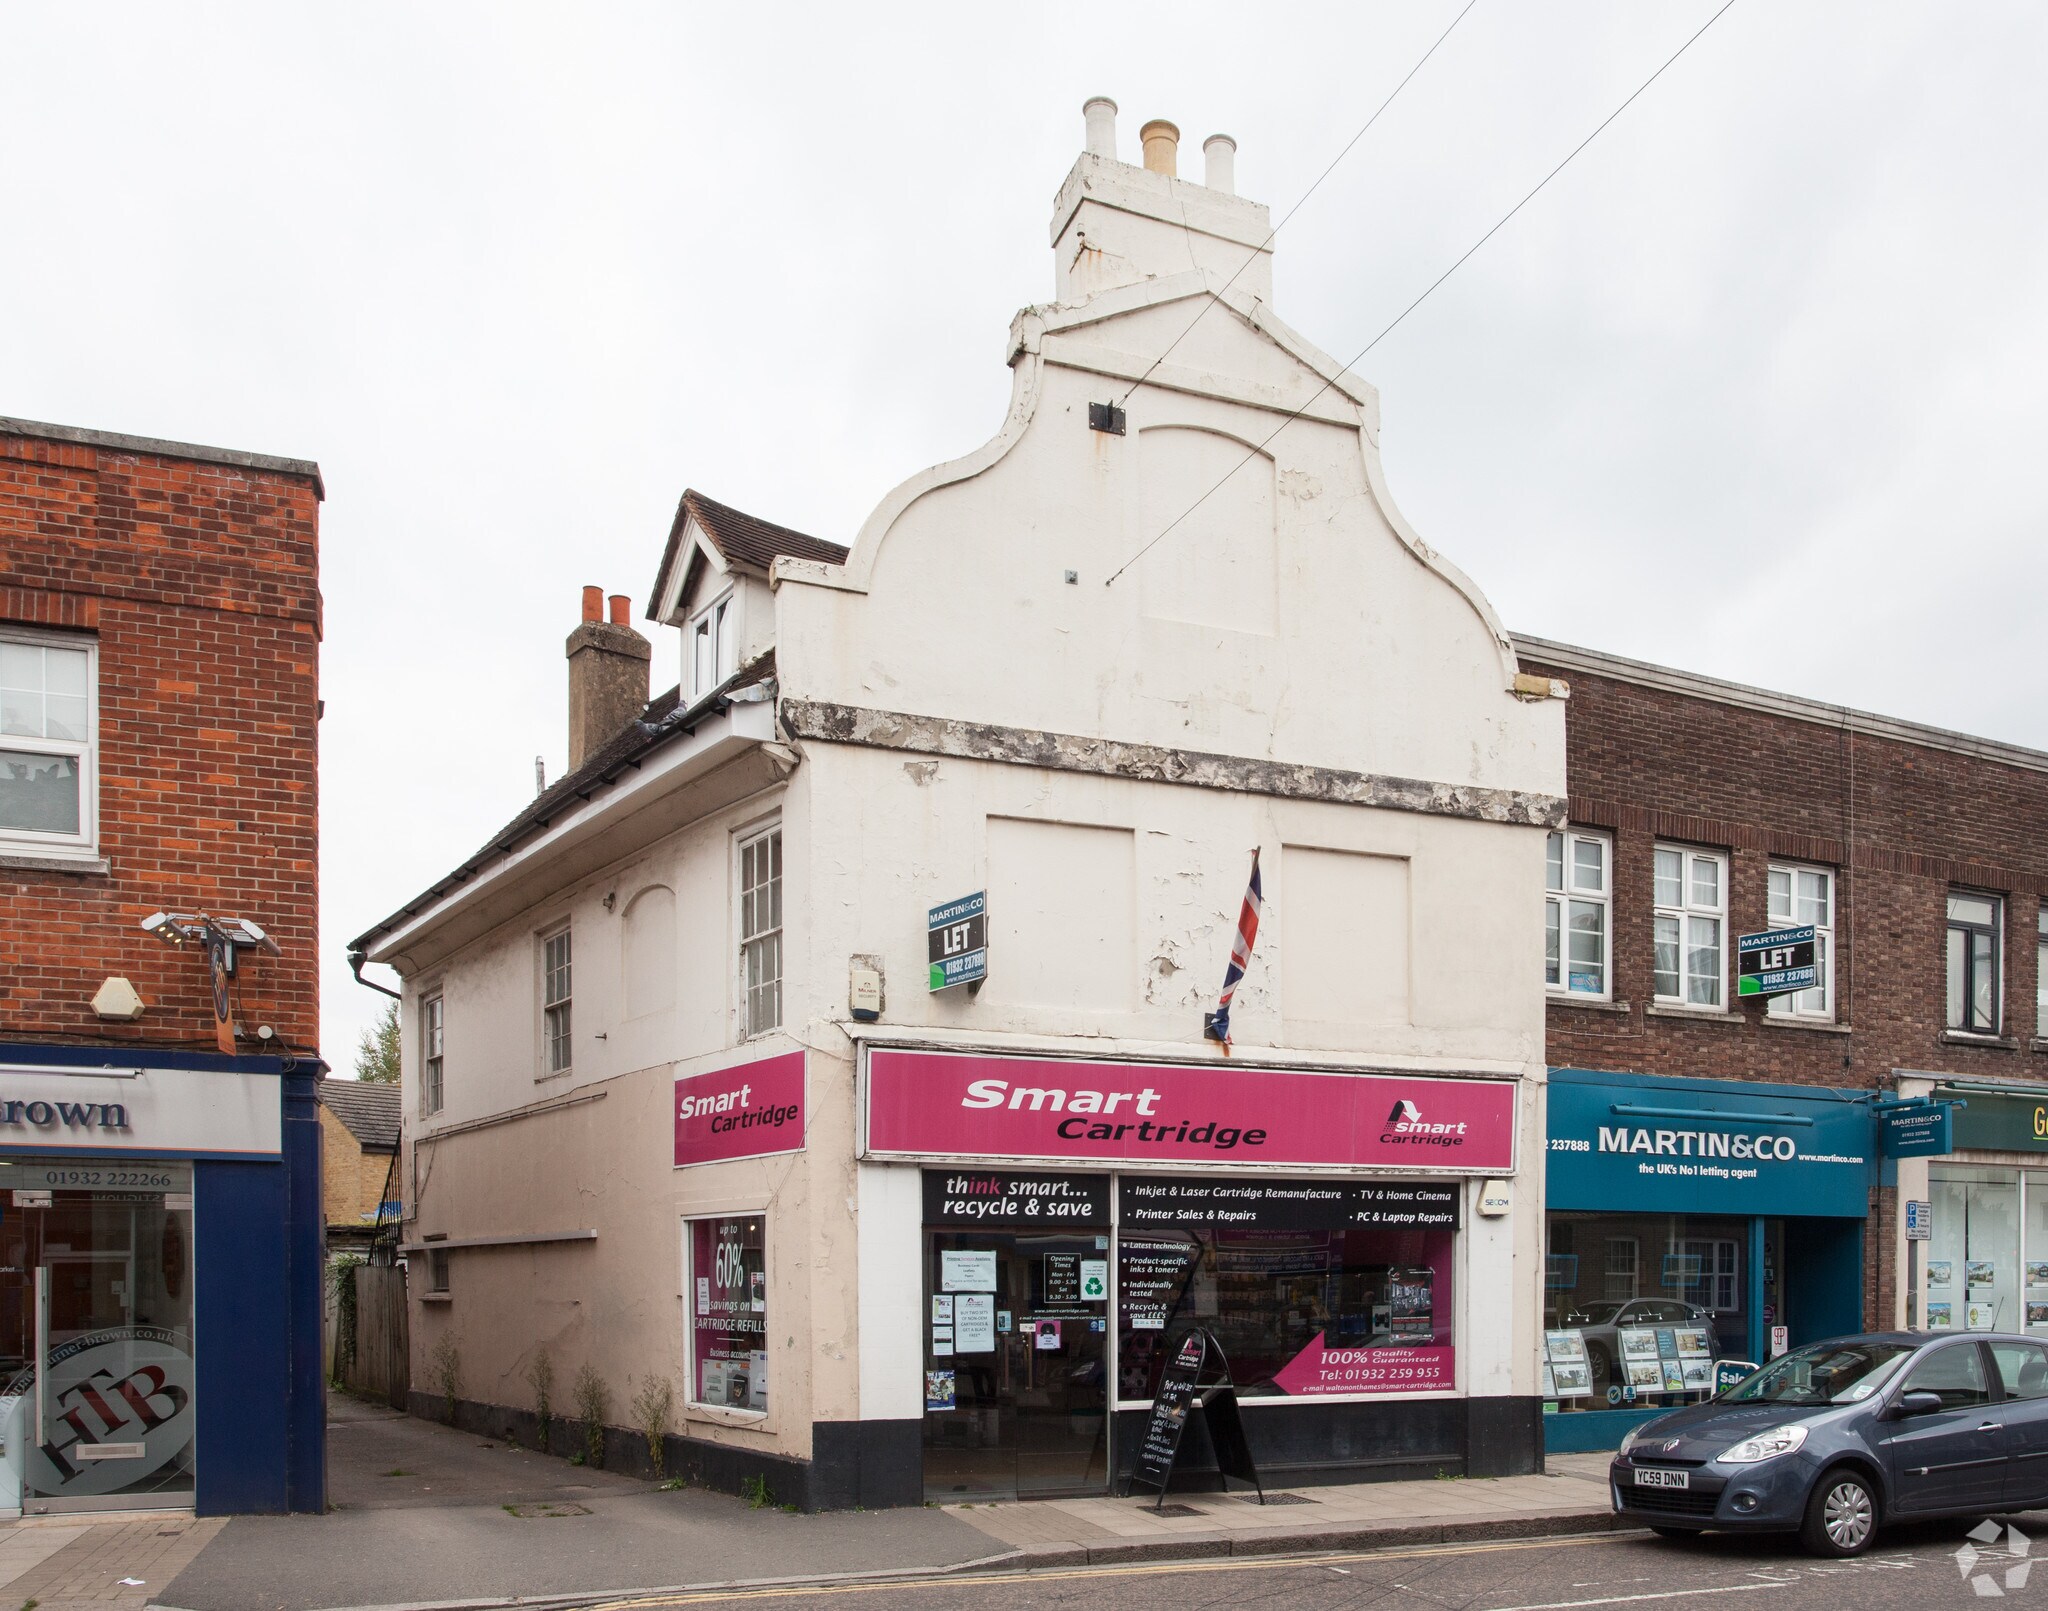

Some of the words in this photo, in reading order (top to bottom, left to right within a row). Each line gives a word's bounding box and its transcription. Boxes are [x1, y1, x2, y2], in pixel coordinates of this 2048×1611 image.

[929, 897, 984, 924] MARTIN&CO
[943, 922, 970, 956] LET
[1741, 929, 1814, 947] MARTIN&CO
[946, 958, 964, 975] 01932
[1760, 947, 1795, 970] LET
[946, 967, 984, 984] www.martinco.com
[1762, 973, 1786, 985] 01932
[1787, 968, 1814, 982] 237888
[1762, 979, 1814, 991] www.martinco.com
[679, 1084, 752, 1120] Smart
[961, 1079, 1162, 1117] Smart
[0, 1099, 129, 1129] rown
[711, 1104, 798, 1134] Cartridge
[1891, 1114, 1942, 1127] MARTIN&CO
[2034, 1106, 2048, 1136] G
[1057, 1117, 1268, 1150] Cartridge
[1394, 1122, 1468, 1135] smart
[1379, 1134, 1464, 1148] Cartridge
[1551, 1139, 1590, 1151] 237888
[1598, 1126, 1797, 1162] MARTIN&CO
[1798, 1153, 1864, 1165] www.martinco.com
[46, 1171, 101, 1185] 01932
[107, 1172, 171, 1187] 222266
[1639, 1162, 1654, 1174] the
[1656, 1163, 1678, 1175] UK's
[1679, 1164, 1698, 1176] No1
[1699, 1165, 1729, 1180] letting
[1731, 1168, 1757, 1180] agent
[946, 1175, 1001, 1195] think
[1007, 1180, 1088, 1197] smart...
[1135, 1186, 1167, 1198] Inkjet
[1169, 1187, 1178, 1196] &
[1181, 1186, 1210, 1197] Laser
[1212, 1187, 1263, 1200] Cartridge
[1265, 1188, 1342, 1200] Remanufacture
[1360, 1190, 1375, 1200] TV
[1376, 1191, 1384, 1200] &
[1386, 1190, 1414, 1200] Home
[1416, 1191, 1452, 1201] Cinema
[1485, 1198, 1508, 1206] SECOM
[943, 1197, 1018, 1219] recycle
[1024, 1198, 1040, 1216] &
[1046, 1201, 1093, 1217] save
[1135, 1209, 1174, 1220] Printer
[1176, 1209, 1204, 1220] Sales
[1206, 1210, 1214, 1220] &
[1217, 1210, 1257, 1222] Repairs
[1909, 1204, 1915, 1214] P
[1356, 1212, 1370, 1222] PC
[1372, 1212, 1380, 1222] &
[1382, 1212, 1416, 1224] Laptop
[1417, 1213, 1453, 1223] Repairs
[720, 1226, 728, 1236] up
[730, 1225, 738, 1234] to
[1152, 1243, 1191, 1251] technology
[715, 1242, 744, 1289] 60%
[1129, 1257, 1188, 1266] Product-specific
[1129, 1281, 1173, 1289] Individually
[709, 1298, 738, 1314] savings
[740, 1301, 750, 1311] on
[1129, 1303, 1158, 1311] Recycle
[695, 1317, 735, 1331] CARTRIDGE
[737, 1319, 767, 1333] REFILLS
[709, 1347, 730, 1358] Business
[1178, 1354, 1199, 1363] Cartridge
[1321, 1351, 1368, 1365] 100%
[1372, 1350, 1415, 1358] Quality
[1372, 1356, 1440, 1364] Guaranteed
[1319, 1369, 1342, 1380] Tel:
[1345, 1368, 1386, 1380] 01932
[1389, 1368, 1413, 1379] 259
[1416, 1367, 1440, 1378] 955
[1302, 1384, 1324, 1392] e-mail
[1326, 1381, 1452, 1392] waltononthames@smart-cartridge.com
[1637, 1470, 1661, 1485] YC59
[1663, 1472, 1685, 1486] DNN
